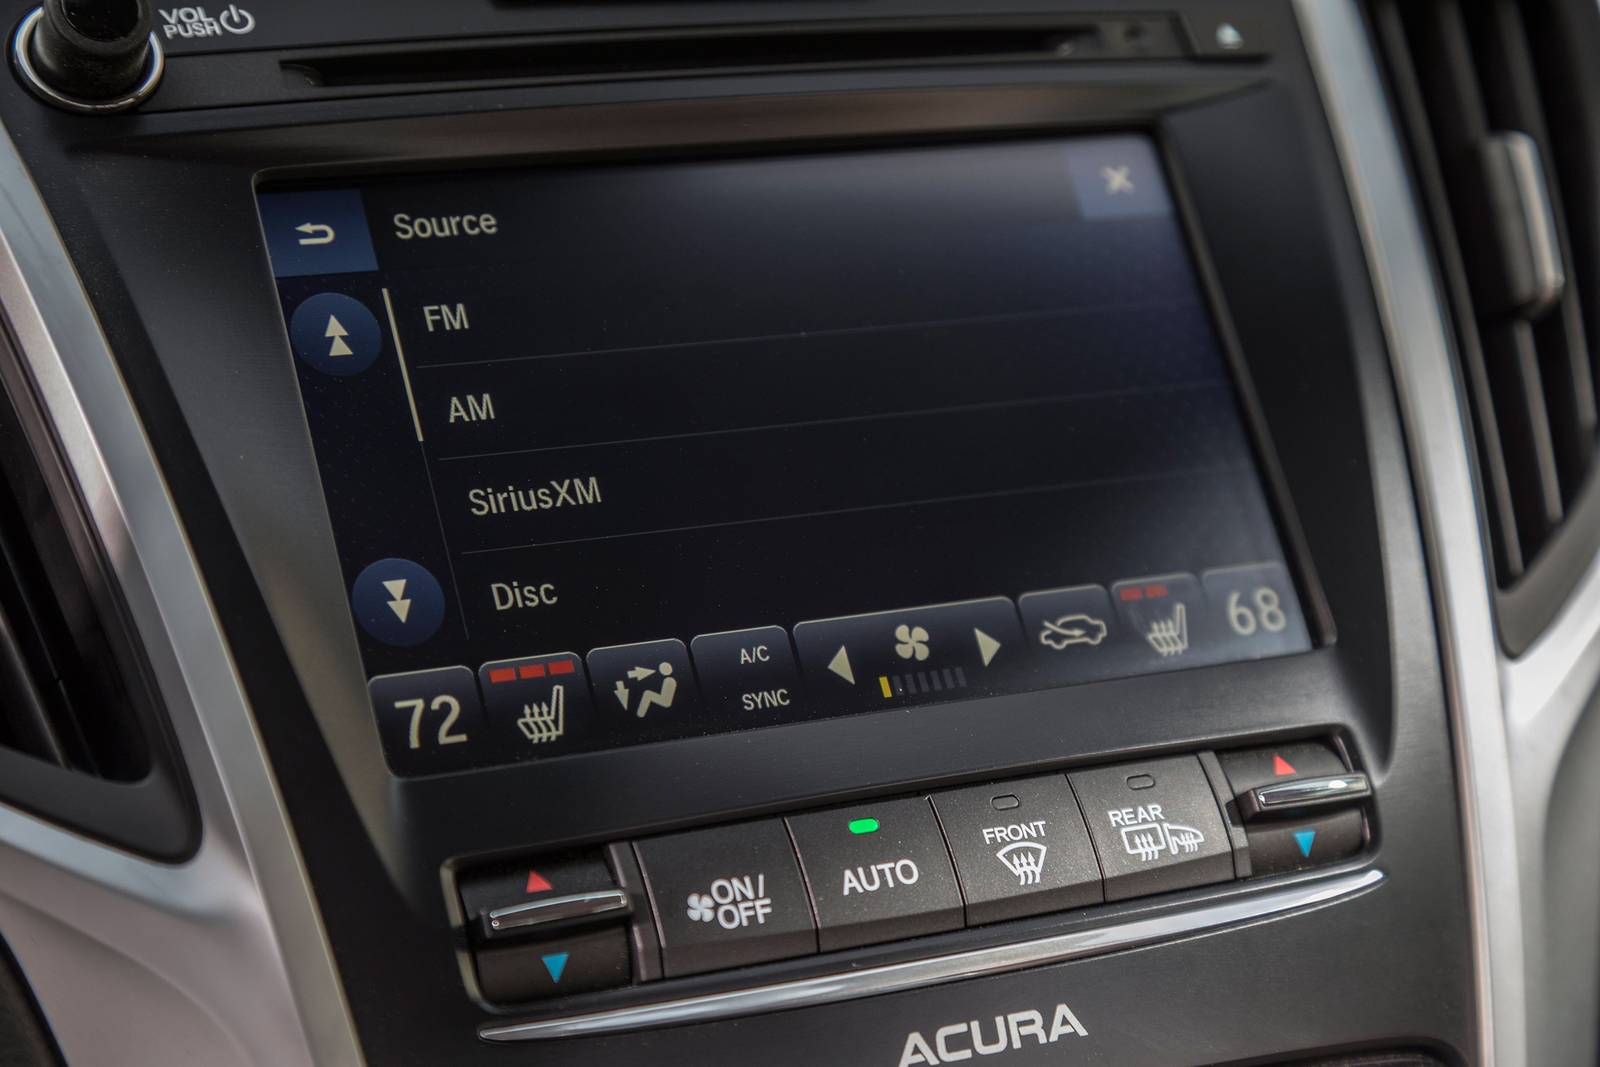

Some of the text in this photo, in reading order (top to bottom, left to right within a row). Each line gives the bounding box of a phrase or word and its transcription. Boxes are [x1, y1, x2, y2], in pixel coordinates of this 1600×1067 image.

[158, 6, 214, 24] VOL
[163, 20, 223, 38] PUSH
[394, 213, 497, 239] Source
[423, 303, 470, 331] FM
[449, 393, 495, 423] AM
[468, 476, 602, 516] SiriusXM
[491, 579, 558, 610] Disc
[1228, 587, 1286, 636] 68
[739, 645, 770, 664] A/C
[741, 688, 791, 710] SYNC
[394, 694, 467, 749] 72
[1108, 804, 1165, 827] REAR
[982, 821, 1047, 844] FRONT
[842, 859, 919, 896] AUTO
[717, 899, 773, 930] OFF
[898, 1003, 1089, 1067] ACURA
